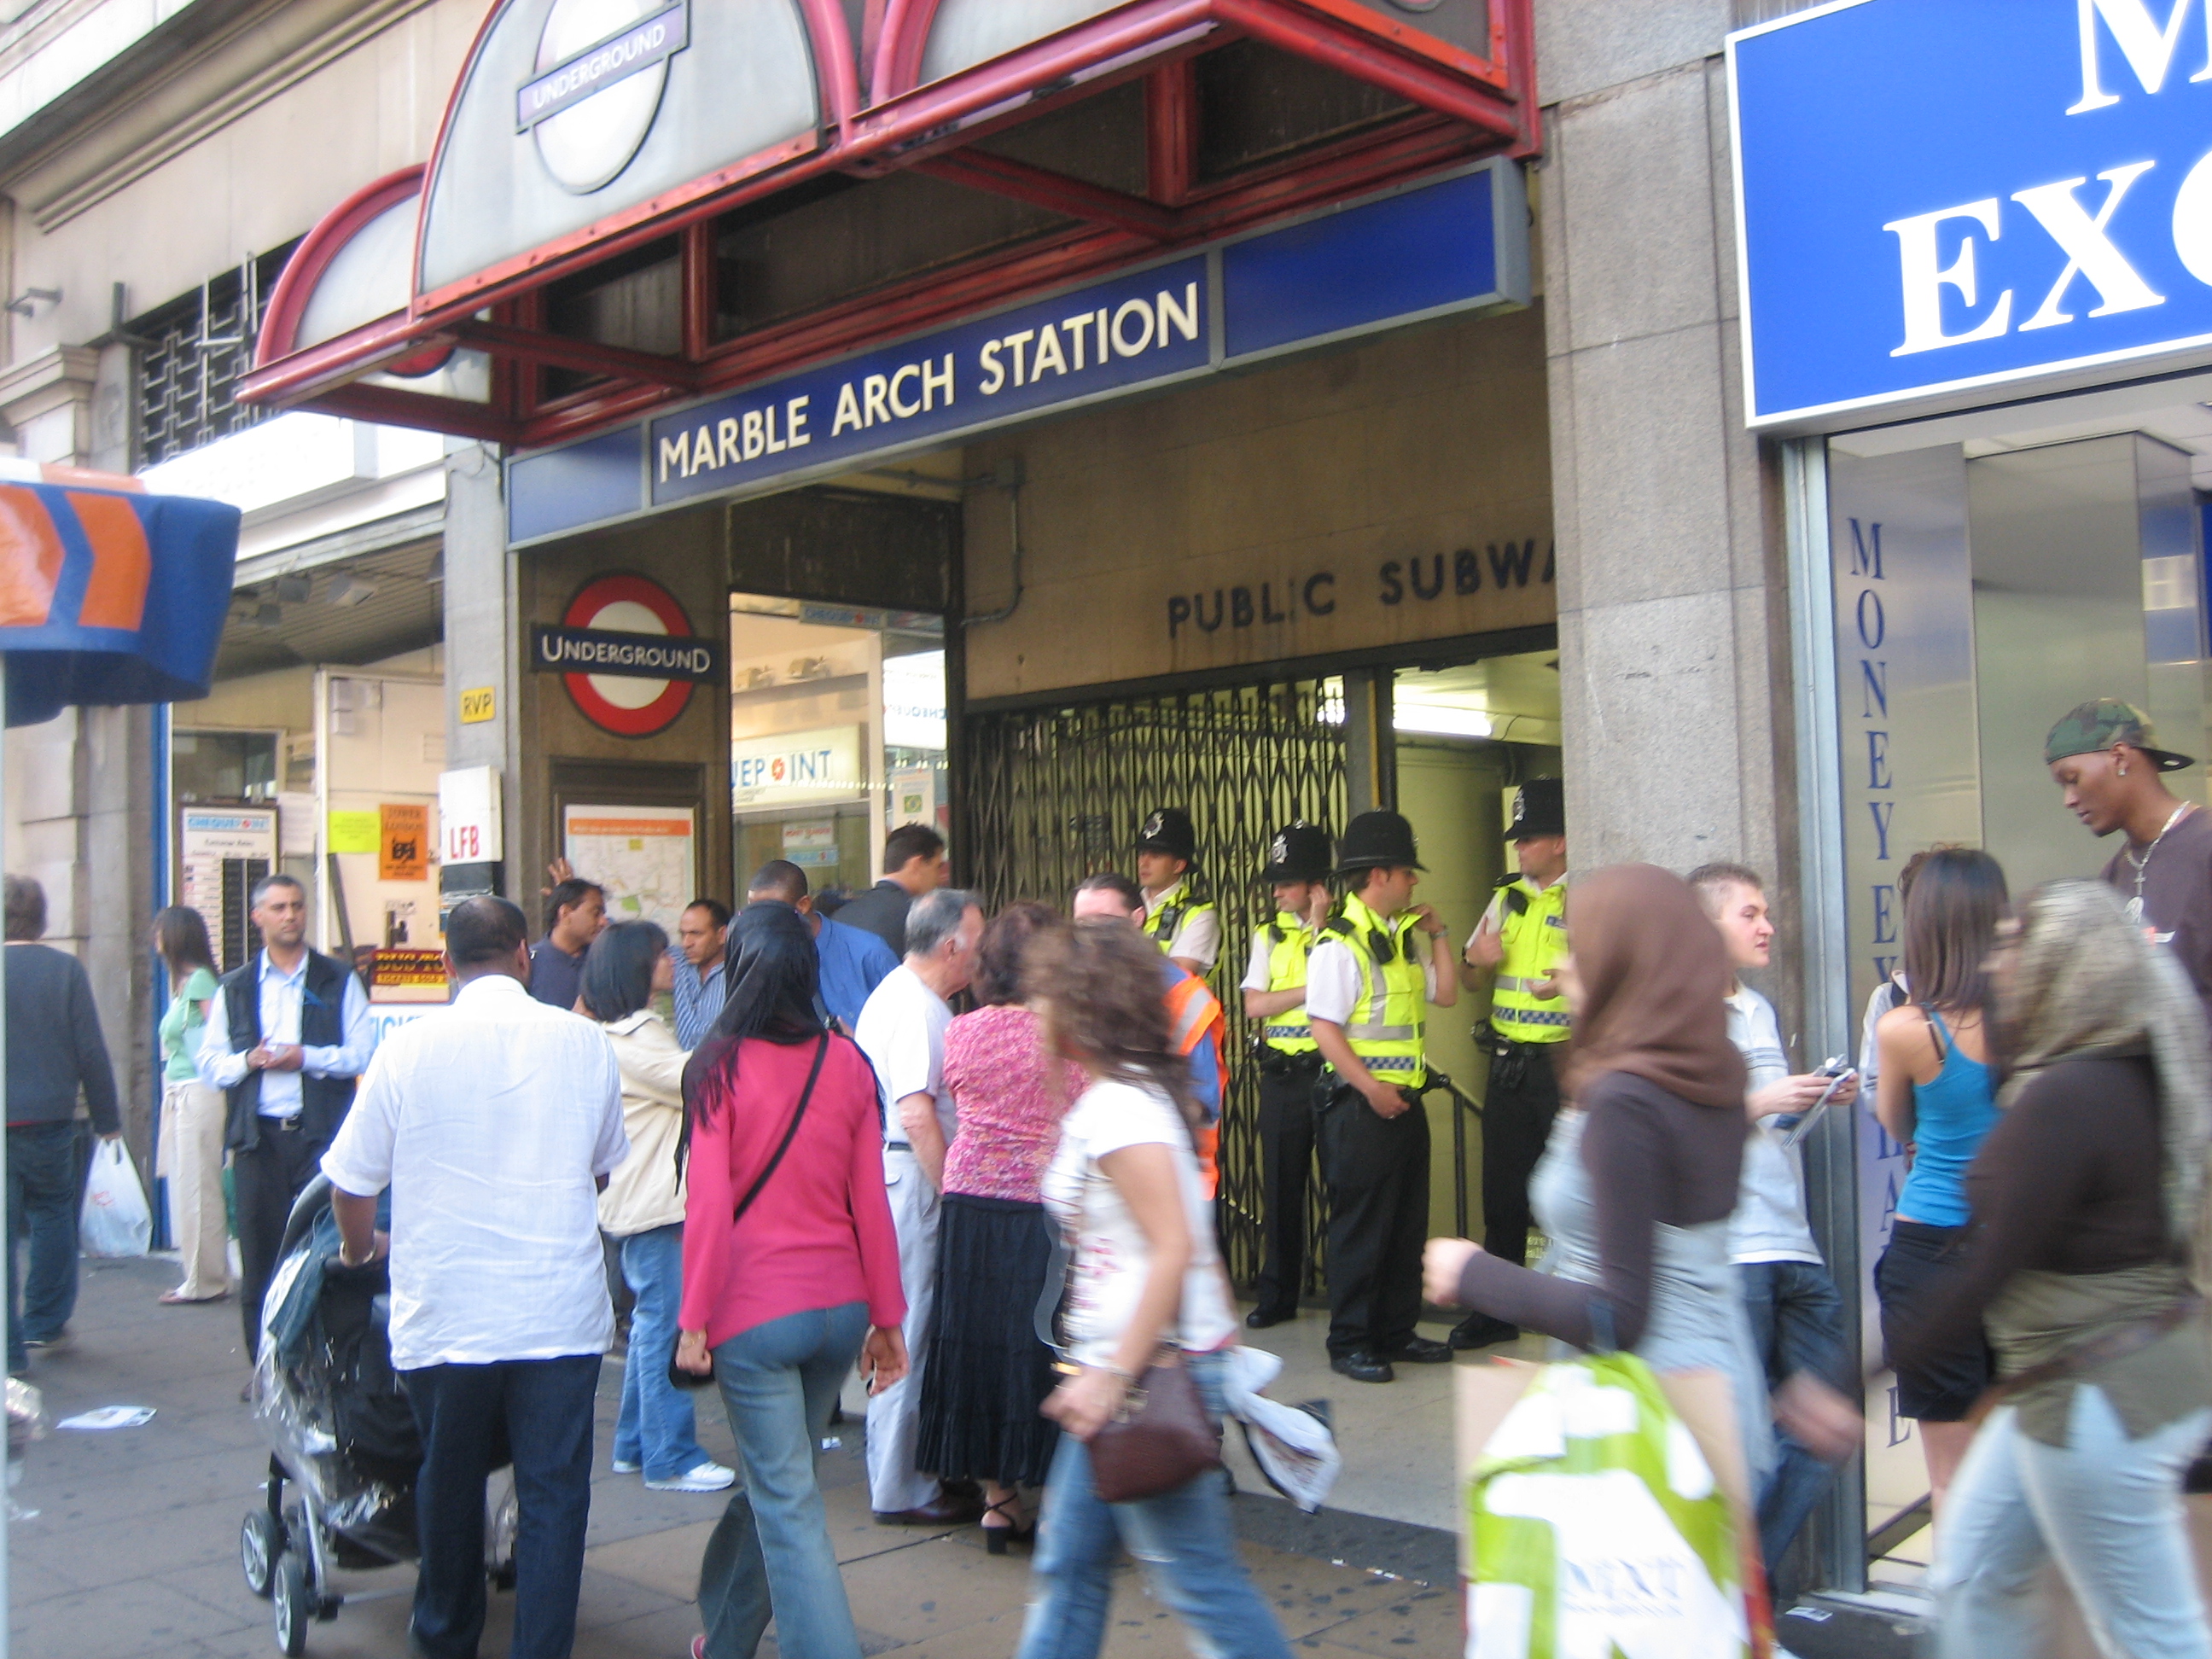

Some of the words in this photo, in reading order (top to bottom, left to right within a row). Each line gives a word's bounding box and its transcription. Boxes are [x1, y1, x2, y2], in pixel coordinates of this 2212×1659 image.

[532, 24, 666, 108] UNDERGROUND
[660, 394, 811, 483] MARBLE
[831, 354, 955, 437] ARCH
[979, 282, 1198, 395] STATION
[1167, 572, 1335, 637] PUBLIC
[541, 634, 711, 673] UNDERGROUND
[463, 693, 492, 715] RVP
[1848, 517, 1892, 860] MONEY
[450, 824, 480, 859] LFB
